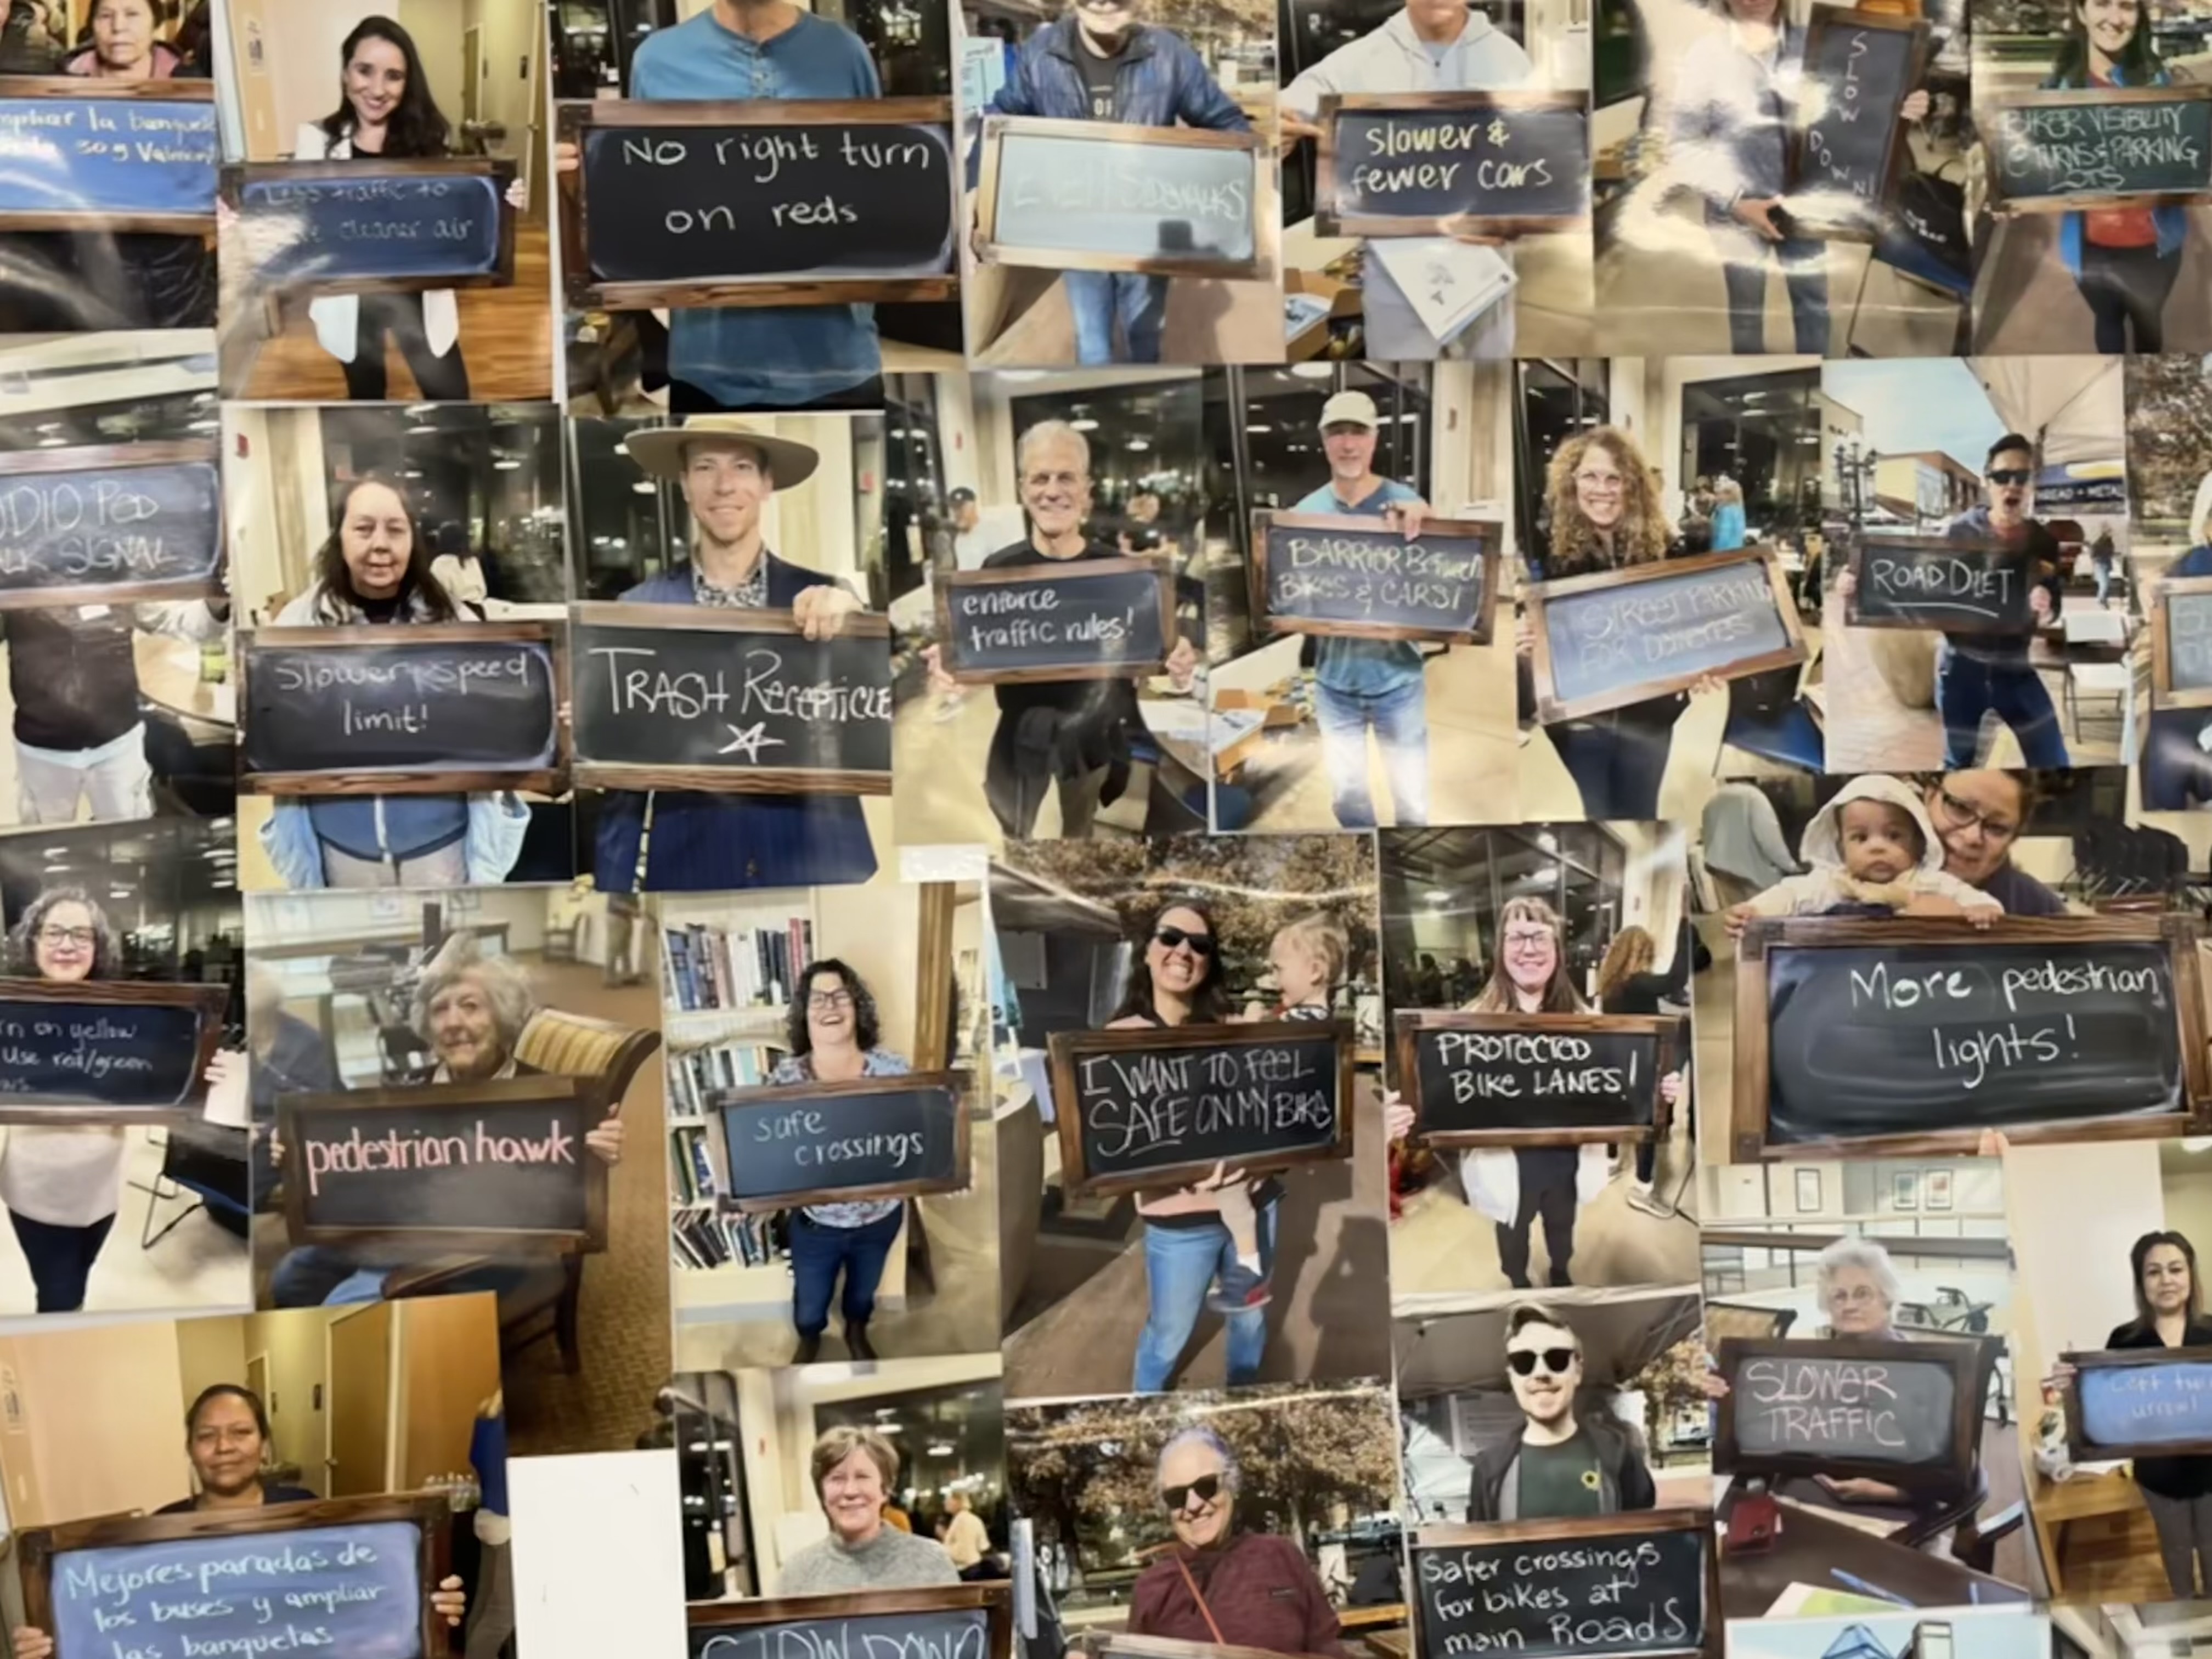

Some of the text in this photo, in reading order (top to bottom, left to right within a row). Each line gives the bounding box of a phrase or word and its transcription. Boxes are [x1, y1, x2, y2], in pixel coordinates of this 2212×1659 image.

[88, 105, 117, 131] la
[1487, 118, 1510, 148] &
[622, 131, 930, 184] No right turn
[1350, 157, 1554, 196] fewer cars
[665, 195, 859, 233] on reds
[343, 699, 429, 736] limit!
[1849, 960, 2160, 1013] More pedestrian
[1932, 1013, 2080, 1090] lights!
[1079, 1054, 1112, 1097] I
[1111, 1053, 1195, 1098] WANT
[1201, 1051, 1239, 1087] TO
[1088, 1096, 1189, 1158] SAFE
[304, 1120, 577, 1197] pedestrian hawk
[794, 1131, 924, 1168] crossings
[1760, 1406, 1906, 1447] TRAFFIC
[65, 1541, 379, 1607] Mejores paradas de
[1514, 1541, 1662, 1589] crossings
[151, 1596, 235, 1622] buses
[252, 1598, 274, 1624] y
[284, 1582, 388, 1614] ampliar
[1435, 1589, 1475, 1622] for
[1588, 1574, 1624, 1605] at
[180, 1625, 334, 1659] banquetas
[1444, 1626, 1526, 1656] main
